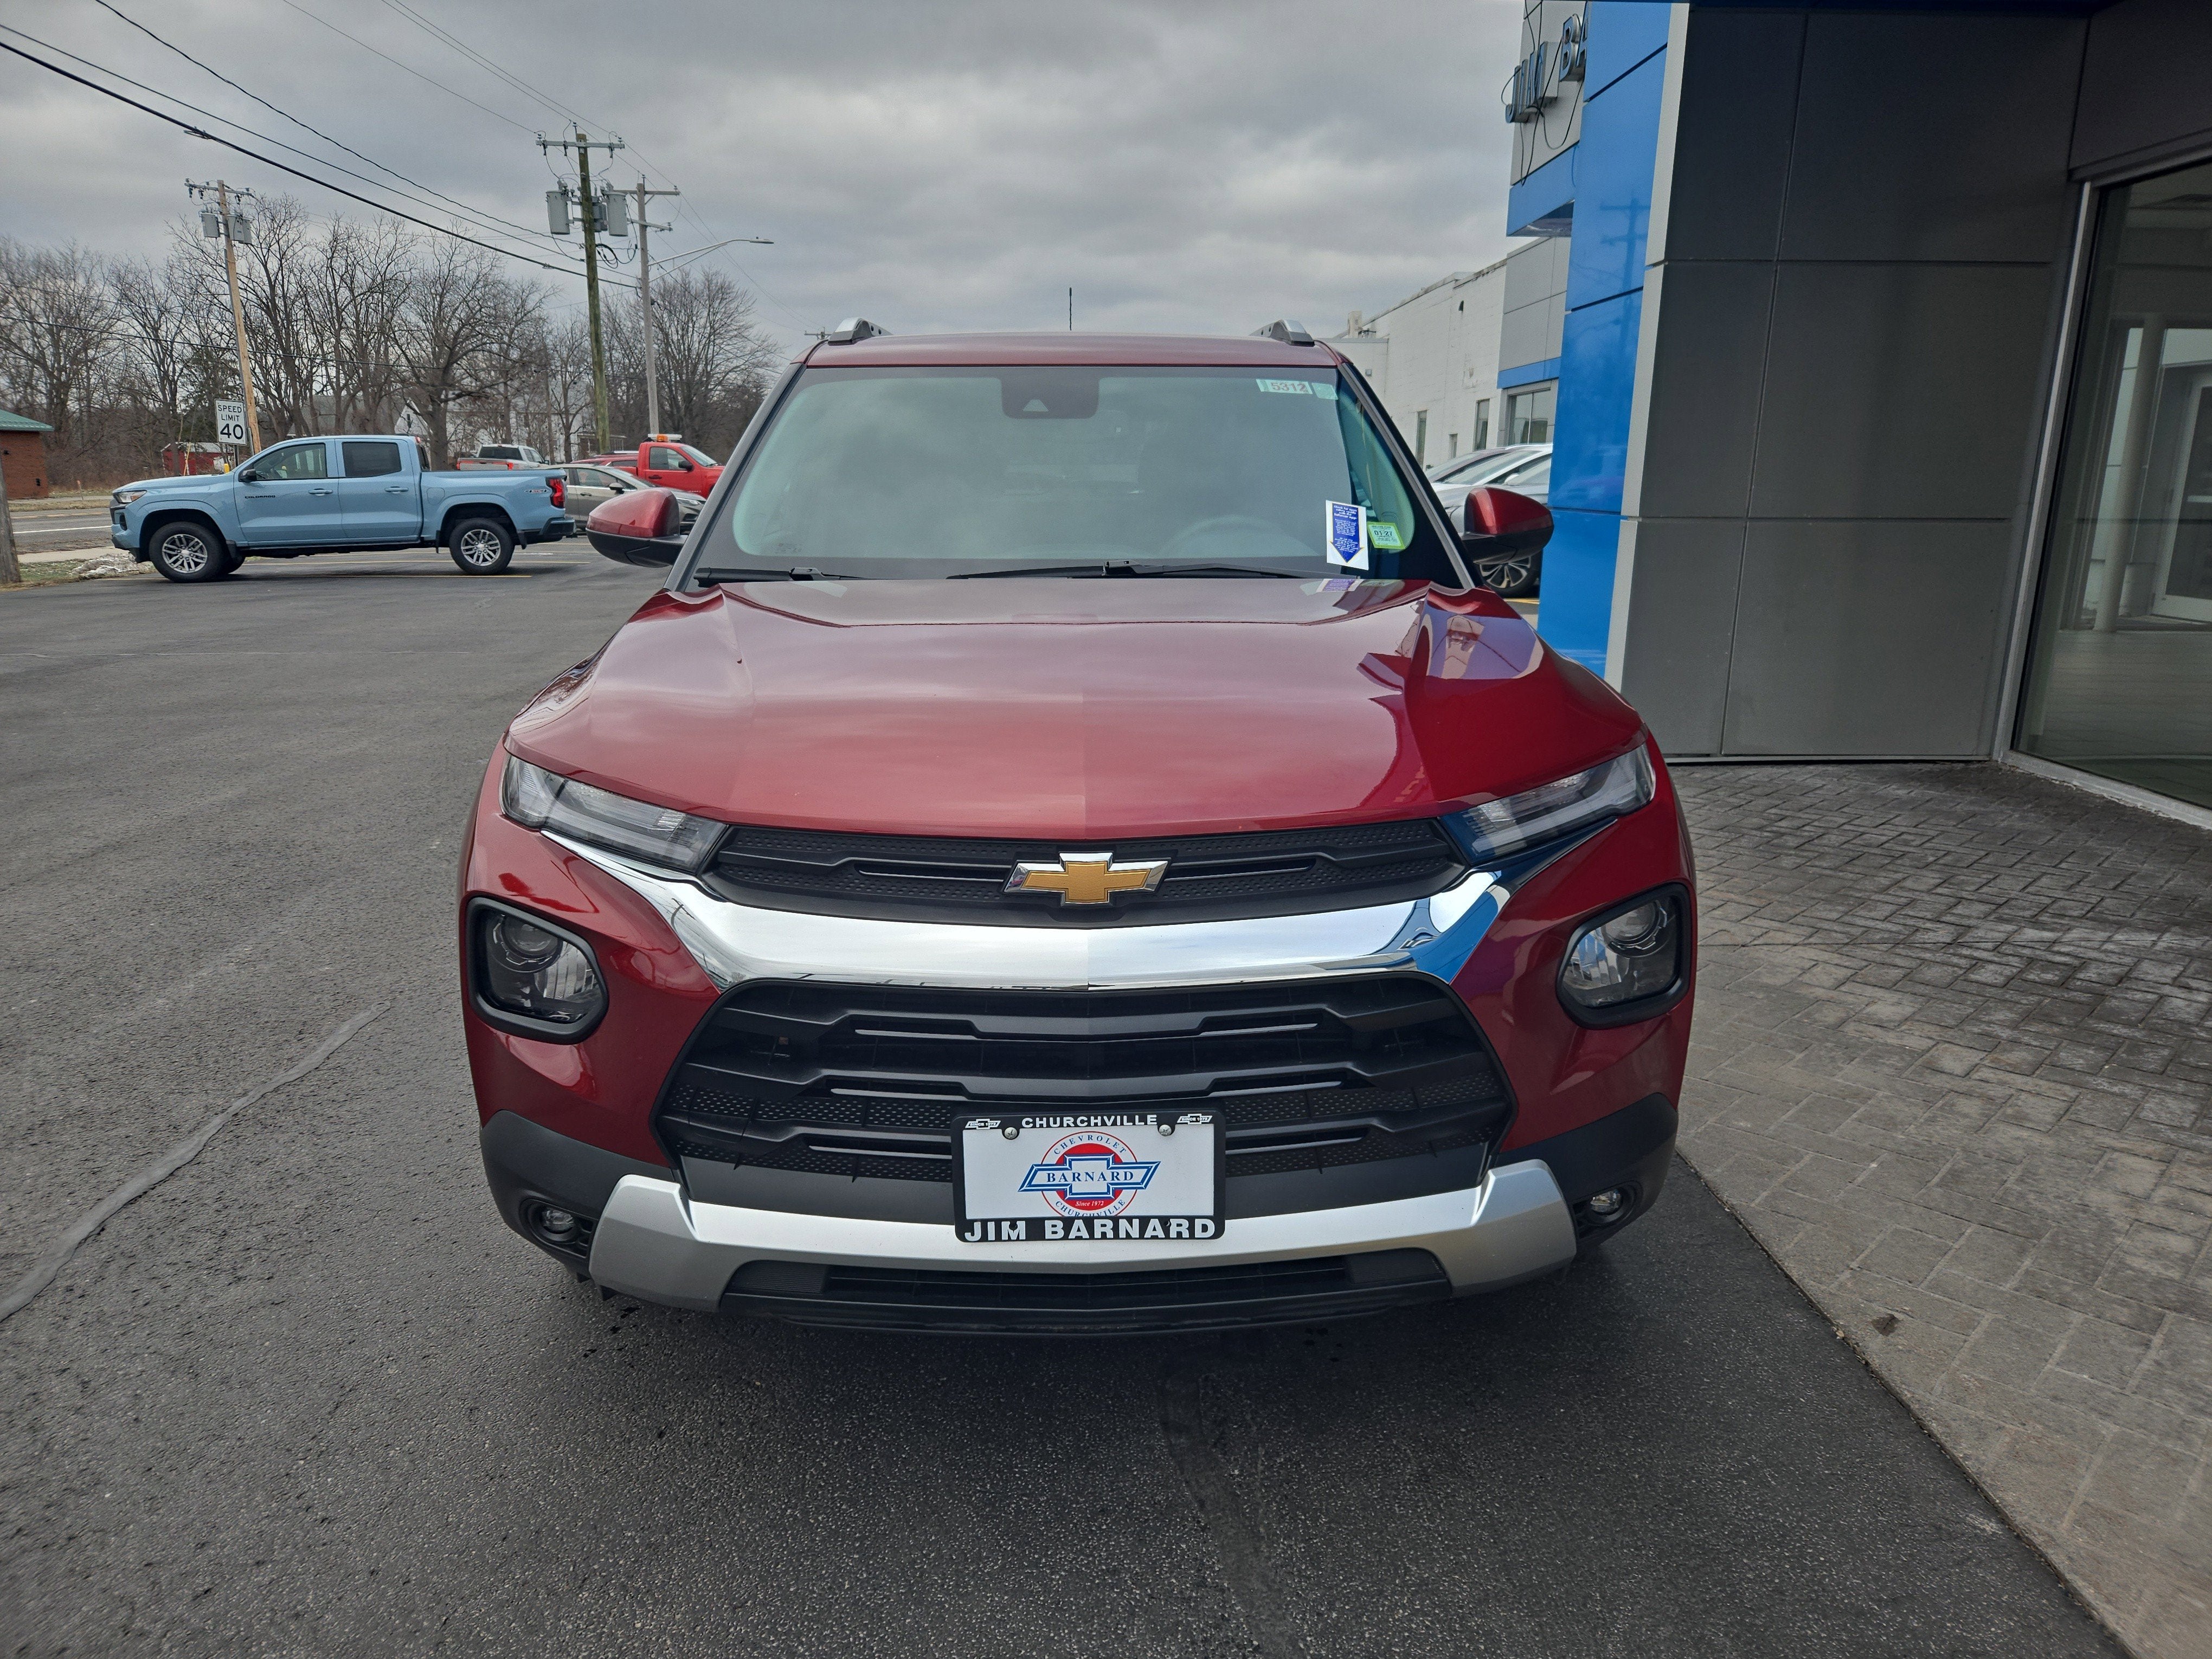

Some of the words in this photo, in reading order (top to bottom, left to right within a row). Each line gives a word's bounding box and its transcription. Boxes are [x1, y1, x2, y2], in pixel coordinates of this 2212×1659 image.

[1505, 40, 1552, 123] JIM
[1270, 382, 1307, 392] 5312
[217, 404, 242, 413] SPEED
[221, 414, 240, 422] LIMIT
[220, 423, 243, 440] 40
[1021, 1114, 1158, 1128] CHURCHVILLE
[1054, 1134, 1127, 1155] CHEVROLET
[1046, 1171, 1134, 1182] BARNARD
[965, 1221, 1026, 1242] JIM
[1045, 1218, 1216, 1240] BARNARD
